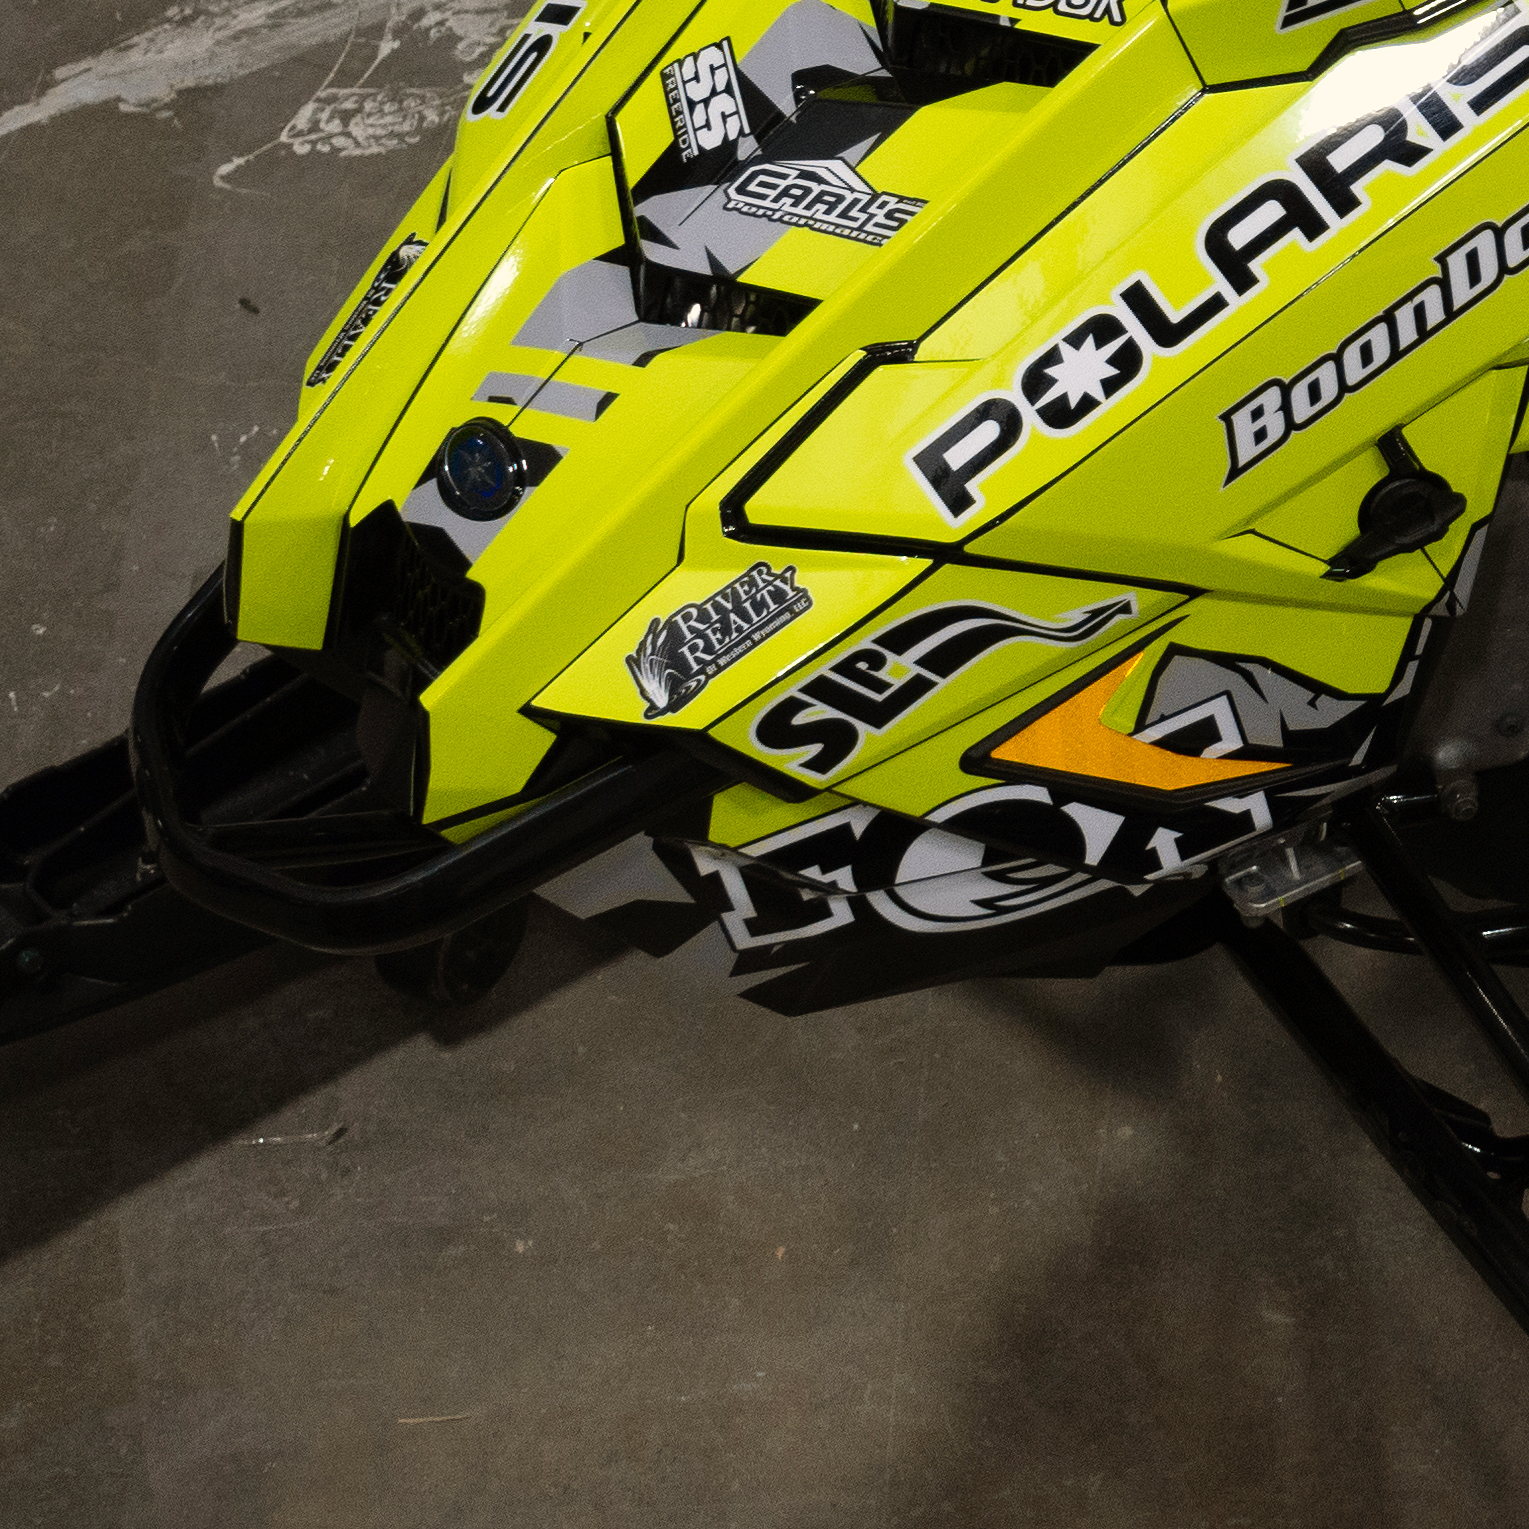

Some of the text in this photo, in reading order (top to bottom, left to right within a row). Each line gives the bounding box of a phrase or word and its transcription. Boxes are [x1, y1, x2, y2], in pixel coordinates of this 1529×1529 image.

[662, 65, 696, 163] FREERIDE
[672, 565, 777, 644] RIVER
[678, 569, 798, 675] REALTY
